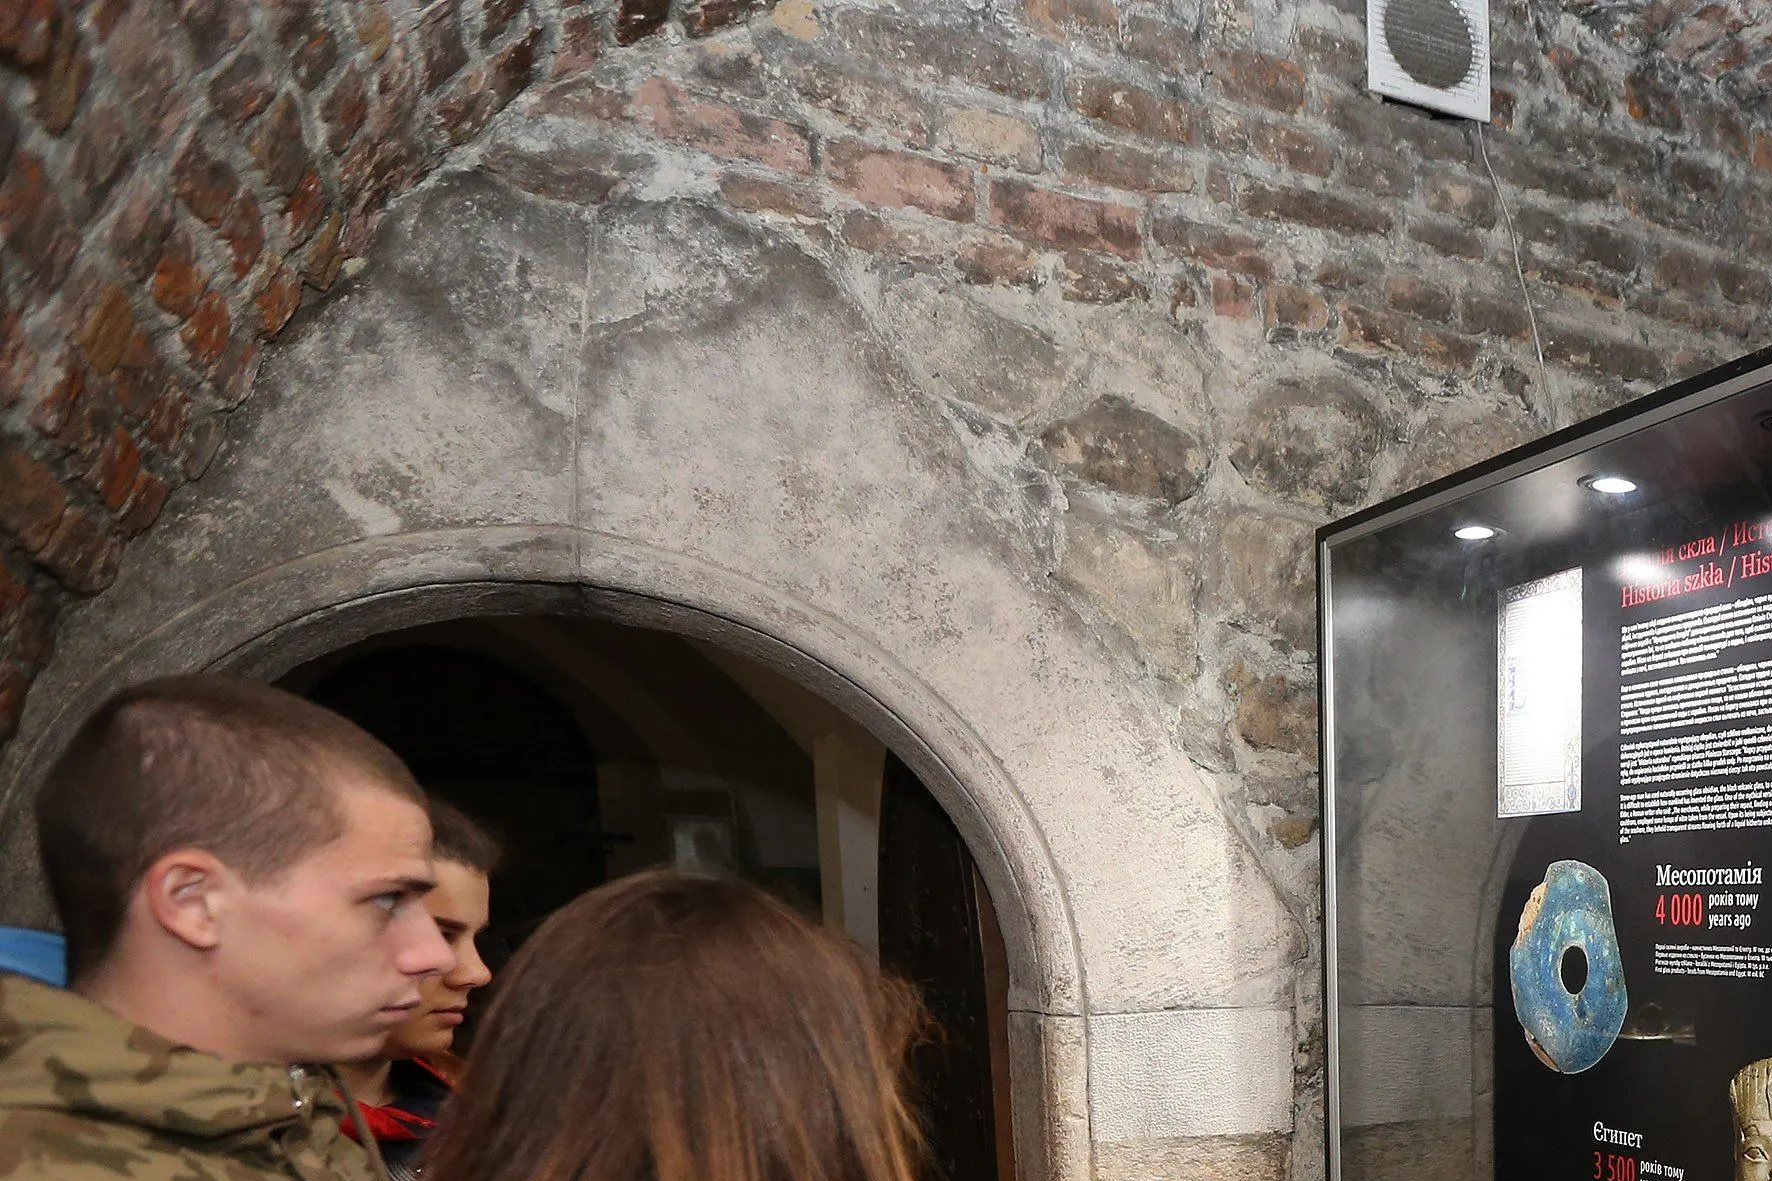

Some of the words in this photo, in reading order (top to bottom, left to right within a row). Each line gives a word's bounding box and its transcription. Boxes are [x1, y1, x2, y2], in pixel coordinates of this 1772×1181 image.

[1679, 536, 1715, 561] скла
[1621, 577, 1681, 608] Historia
[1685, 563, 1724, 592] szkła
[1655, 861, 1763, 887] Месопотамія
[1655, 894, 1666, 925] 4
[1670, 893, 1703, 926] 000
[1708, 890, 1733, 908] років
[1735, 893, 1759, 910] тому
[1708, 912, 1732, 931] years
[1734, 913, 1751, 928] ago
[1593, 1121, 1643, 1149] Єгипет
[1593, 1151, 1602, 1180] 3
[1640, 1158, 1662, 1177] років
